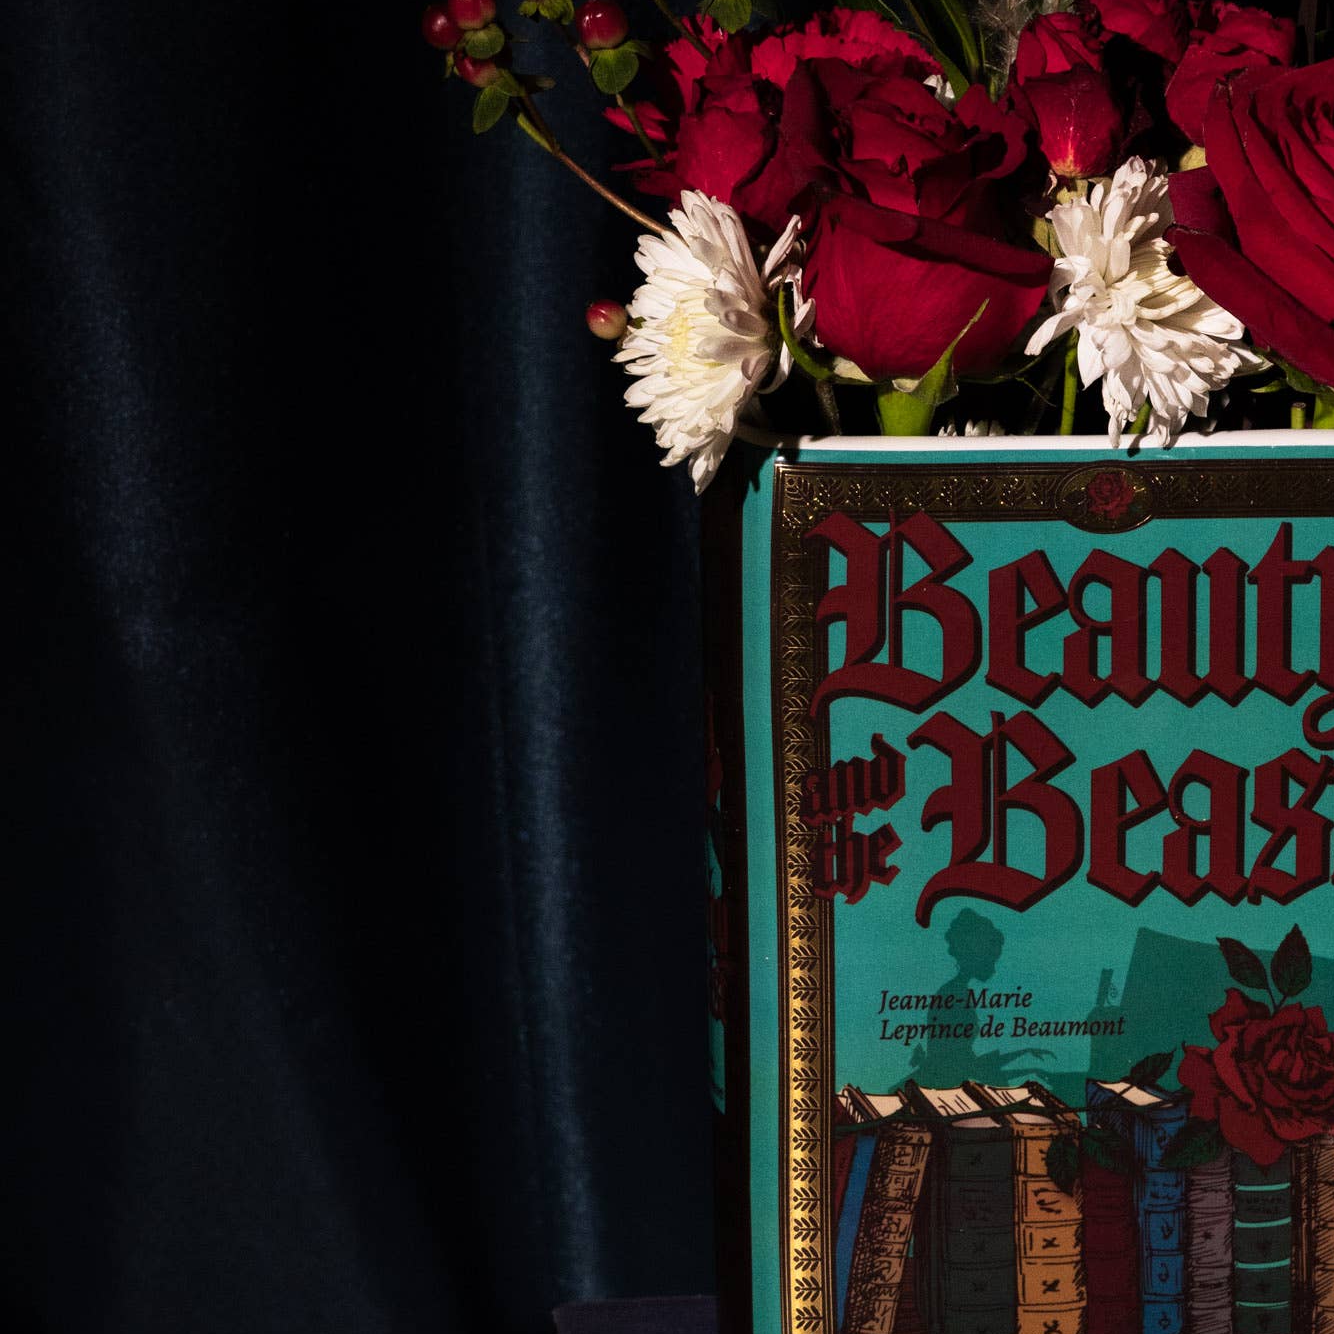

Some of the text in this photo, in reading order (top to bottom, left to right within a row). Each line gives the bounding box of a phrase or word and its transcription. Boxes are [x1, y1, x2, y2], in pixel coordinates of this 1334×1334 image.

[799, 733, 907, 826] and
[810, 816, 903, 905] the
[878, 986, 1033, 1014] Jeanne-Marie
[880, 1015, 1126, 1046] Leprince de Beaumont
